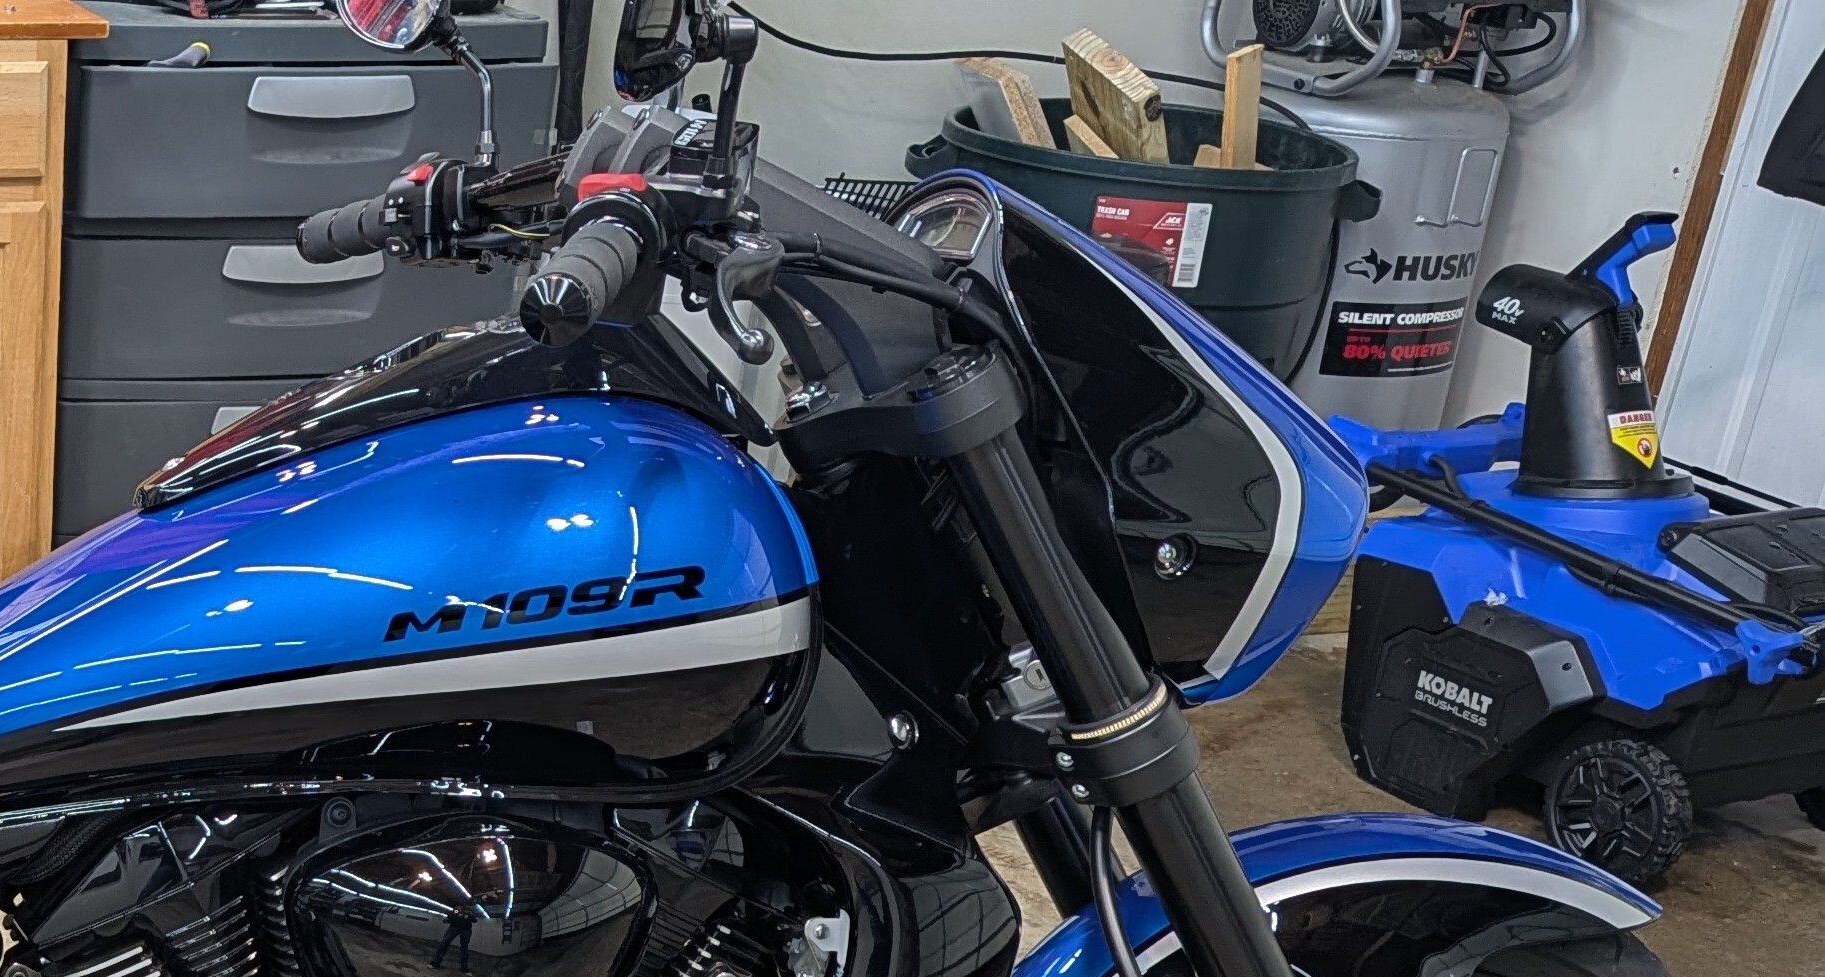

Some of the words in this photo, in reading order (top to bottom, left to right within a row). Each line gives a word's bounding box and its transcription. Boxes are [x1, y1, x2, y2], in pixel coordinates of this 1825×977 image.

[1392, 250, 1479, 282] HUSKY
[1337, 311, 1395, 326] SILENT
[1396, 306, 1465, 326] COMPRESSOR
[1491, 311, 1518, 324] MAX
[1342, 344, 1386, 360] 80%
[1390, 340, 1453, 362] QUIETER
[1619, 413, 1653, 425] DANGER
[383, 565, 706, 643] M109R
[1417, 669, 1493, 715] KOBALT
[1415, 689, 1488, 727] BRUSHLESS
